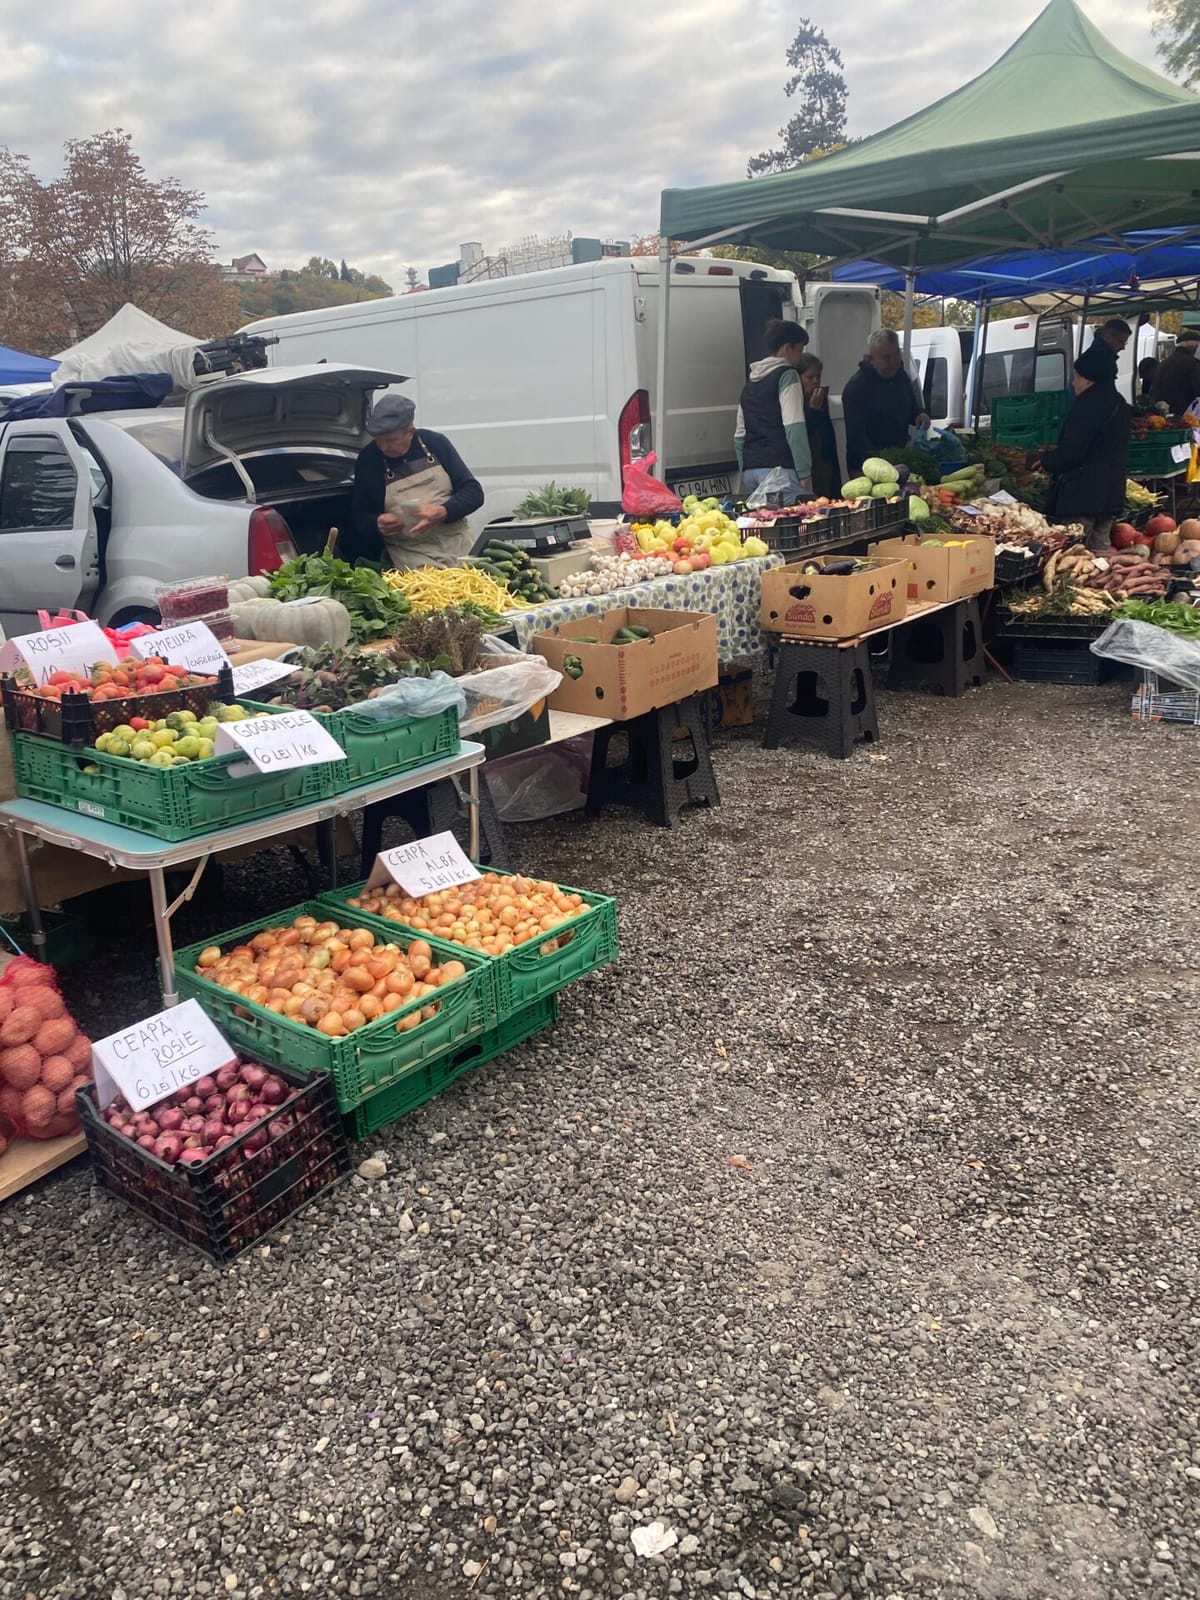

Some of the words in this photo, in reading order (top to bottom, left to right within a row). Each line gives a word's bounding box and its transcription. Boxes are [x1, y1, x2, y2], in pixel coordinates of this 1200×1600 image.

[694, 481, 708, 496] 94
[233, 713, 313, 738] GOGONELE
[253, 746, 271, 764] 6
[388, 842, 429, 866] CEAPĂ
[425, 851, 457, 872] ALBĂ
[420, 877, 433, 890] 5
[152, 1030, 199, 1067] ROȘIE
[136, 1079, 150, 1099] 6
